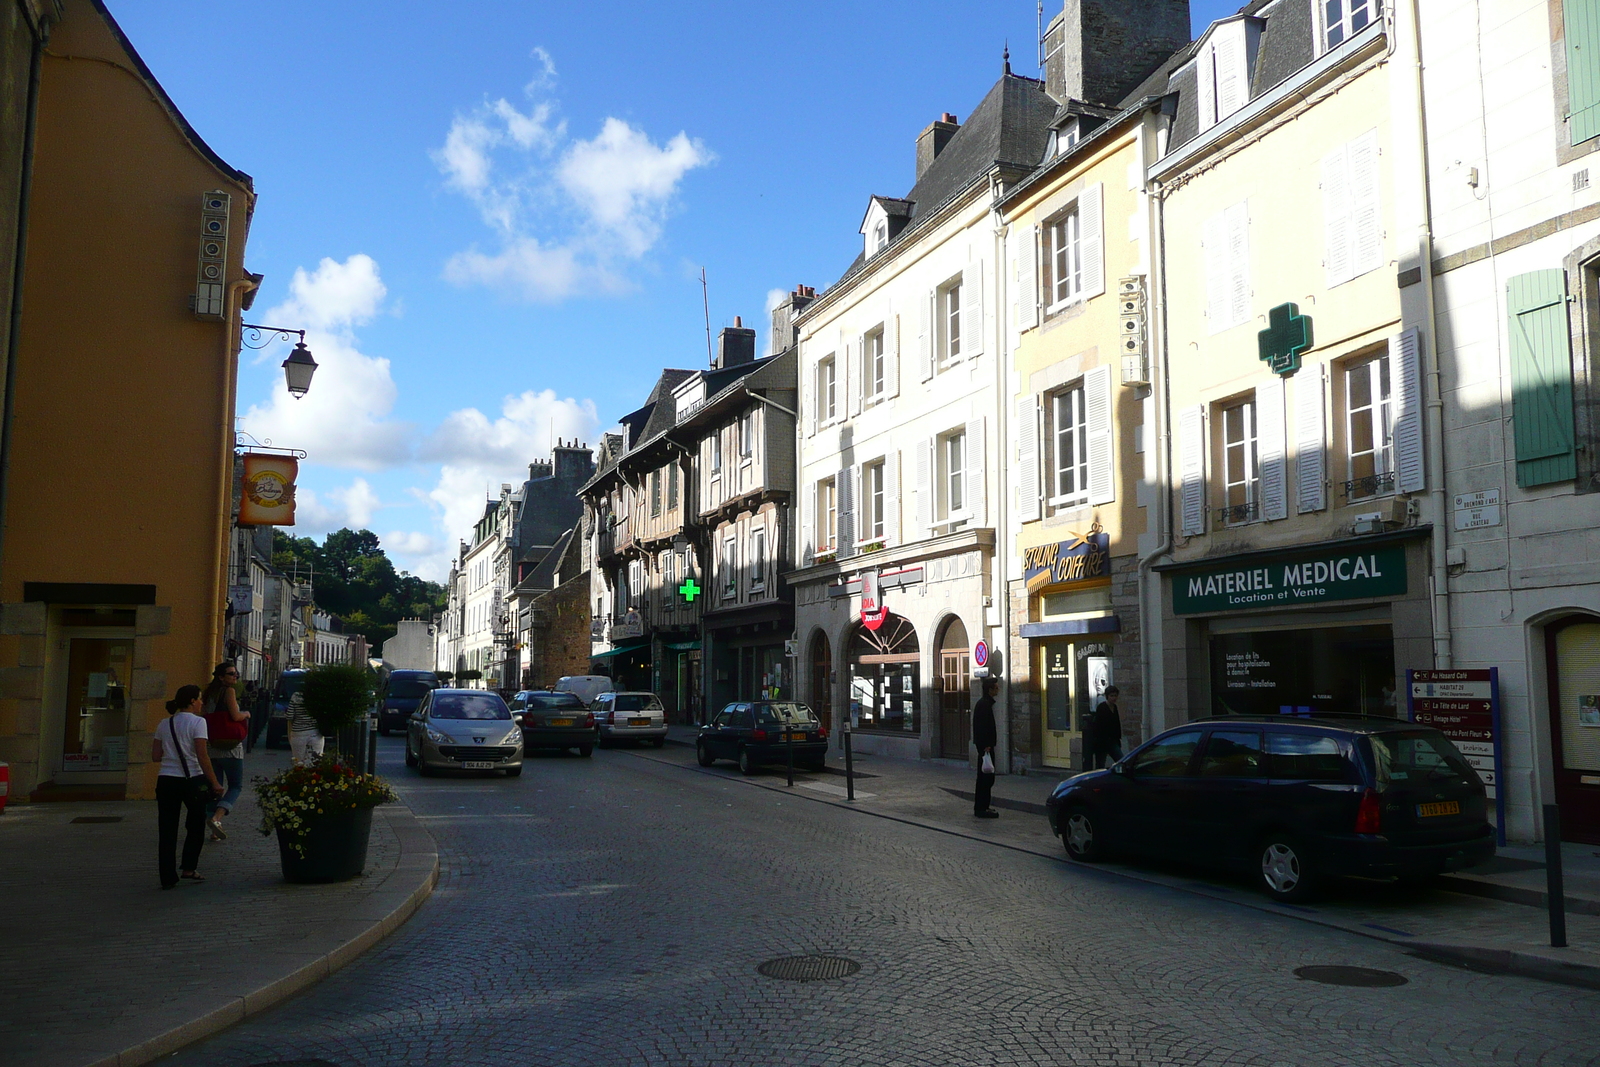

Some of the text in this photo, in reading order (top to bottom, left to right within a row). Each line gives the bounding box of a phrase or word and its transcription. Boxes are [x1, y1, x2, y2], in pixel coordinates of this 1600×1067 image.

[1024, 542, 1060, 571] STYLING
[1058, 551, 1106, 581] COIFFURE
[1188, 555, 1382, 598] MATERIEL MEDICAL
[862, 598, 875, 609] DIA
[1229, 587, 1326, 604] Location et Vente
[1077, 643, 1097, 660] SALON
[1226, 652, 1244, 661] Location
[1245, 652, 1251, 660] de
[1226, 662, 1237, 670] pour
